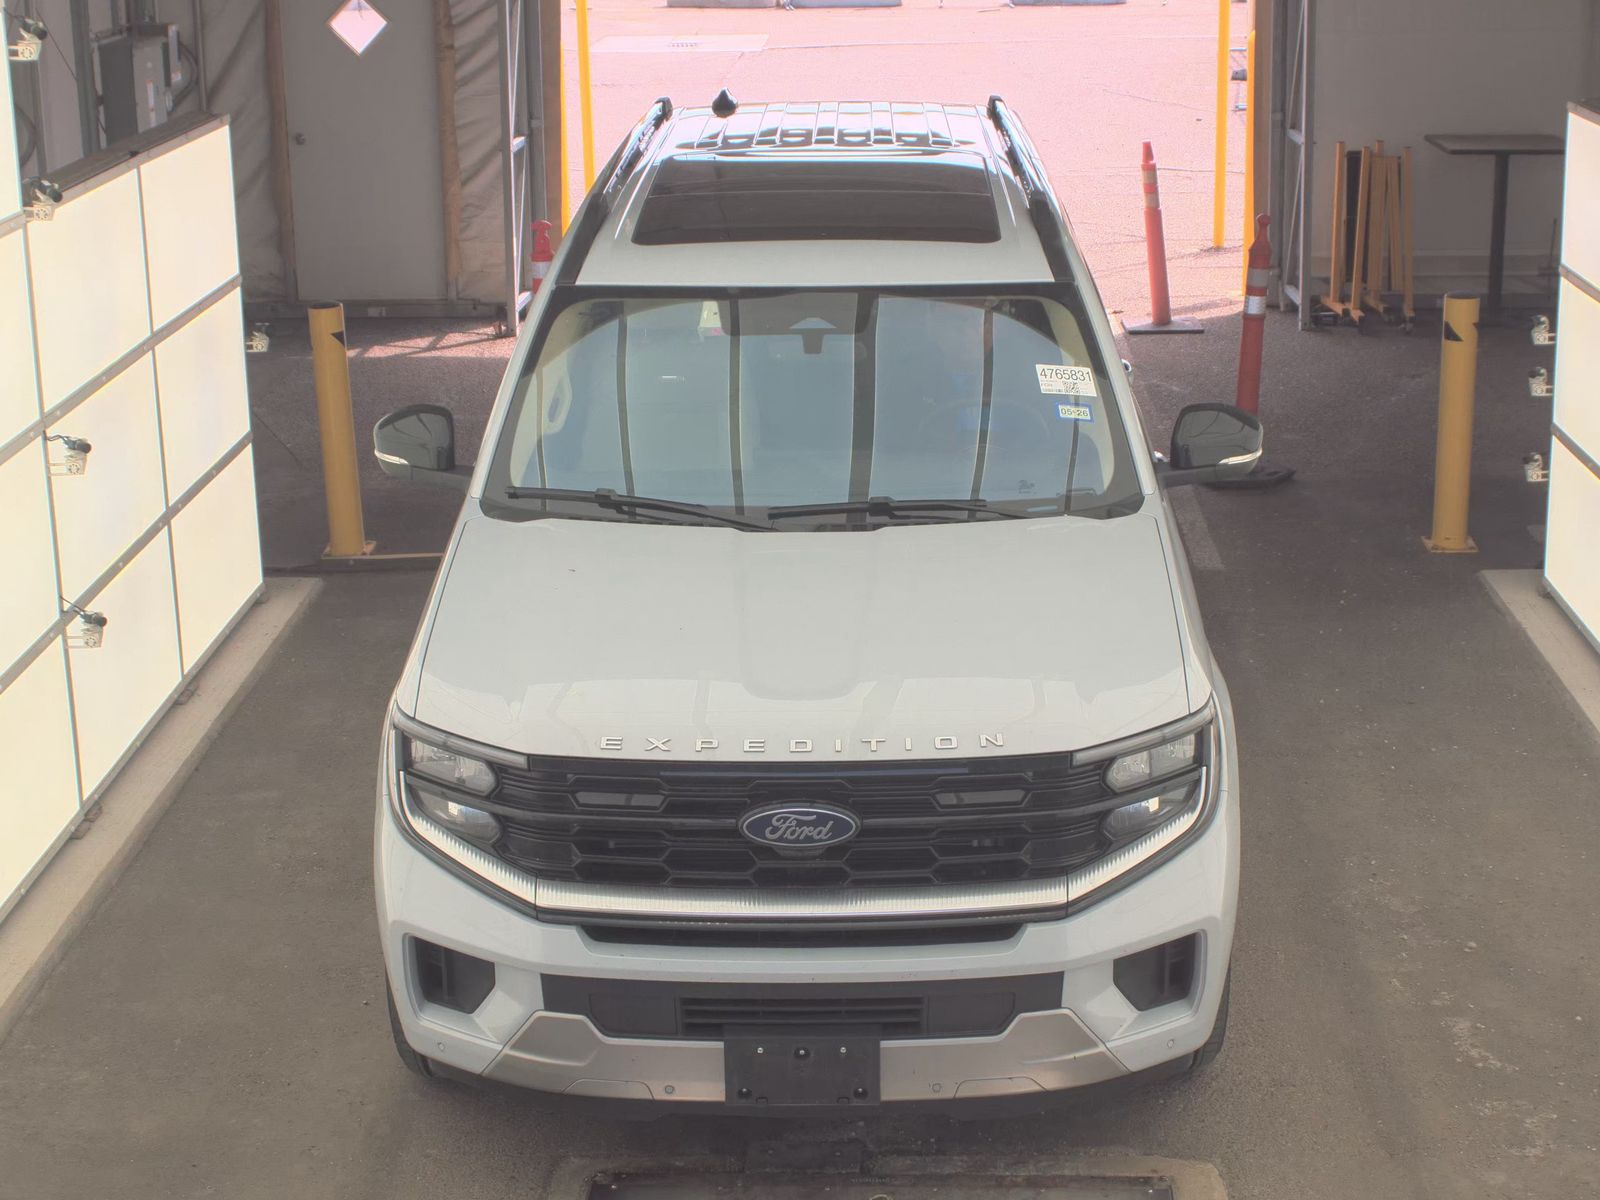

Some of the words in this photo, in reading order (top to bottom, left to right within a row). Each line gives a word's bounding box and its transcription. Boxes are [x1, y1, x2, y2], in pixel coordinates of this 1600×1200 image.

[1040, 368, 1092, 382] 4765831
[600, 733, 1004, 752] EXPEDITION
[765, 814, 834, 840] Ford
